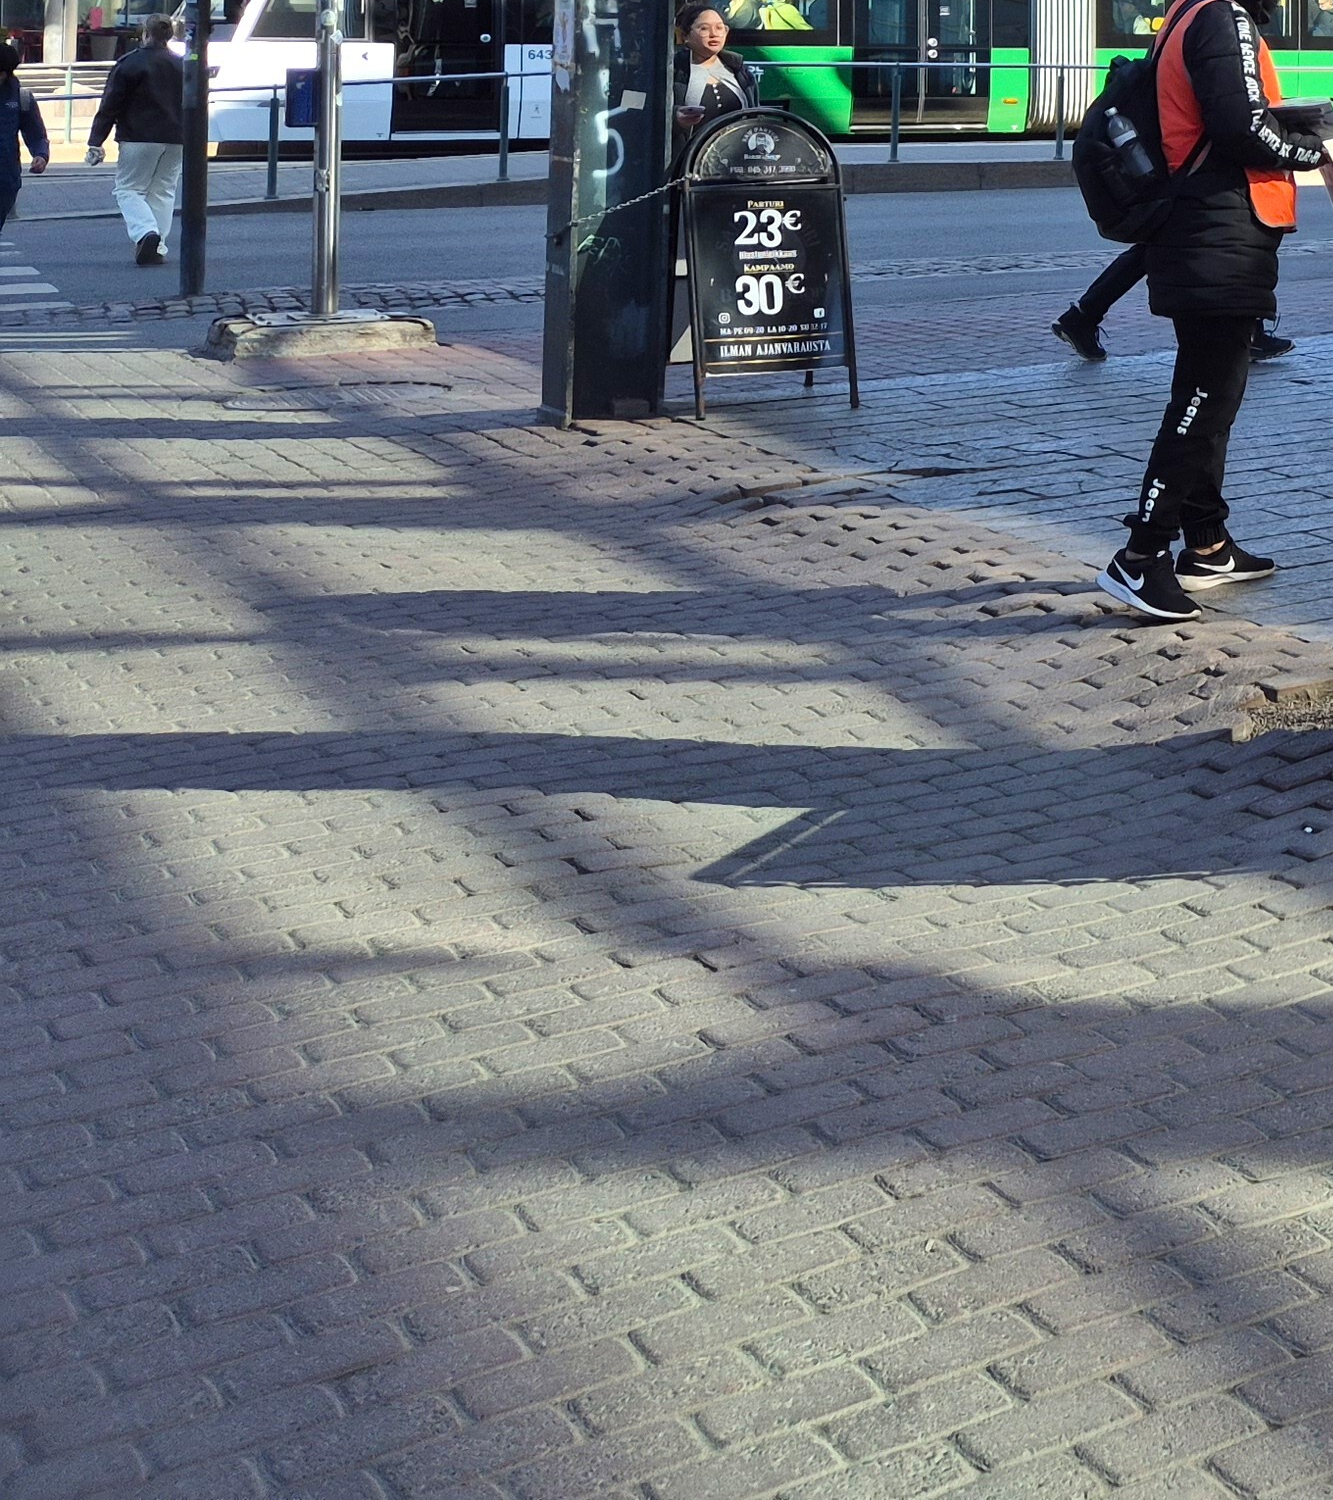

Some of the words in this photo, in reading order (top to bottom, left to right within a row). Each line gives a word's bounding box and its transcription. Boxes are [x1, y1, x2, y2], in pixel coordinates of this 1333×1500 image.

[528, 49, 553, 60] 643
[747, 200, 784, 209] PARTURI
[733, 209, 802, 248] 23€
[735, 273, 805, 315] 30€
[720, 344, 752, 357] ILMAN
[756, 339, 831, 356] AJANVARAUSTA
[1177, 387, 1208, 435] Jeans
